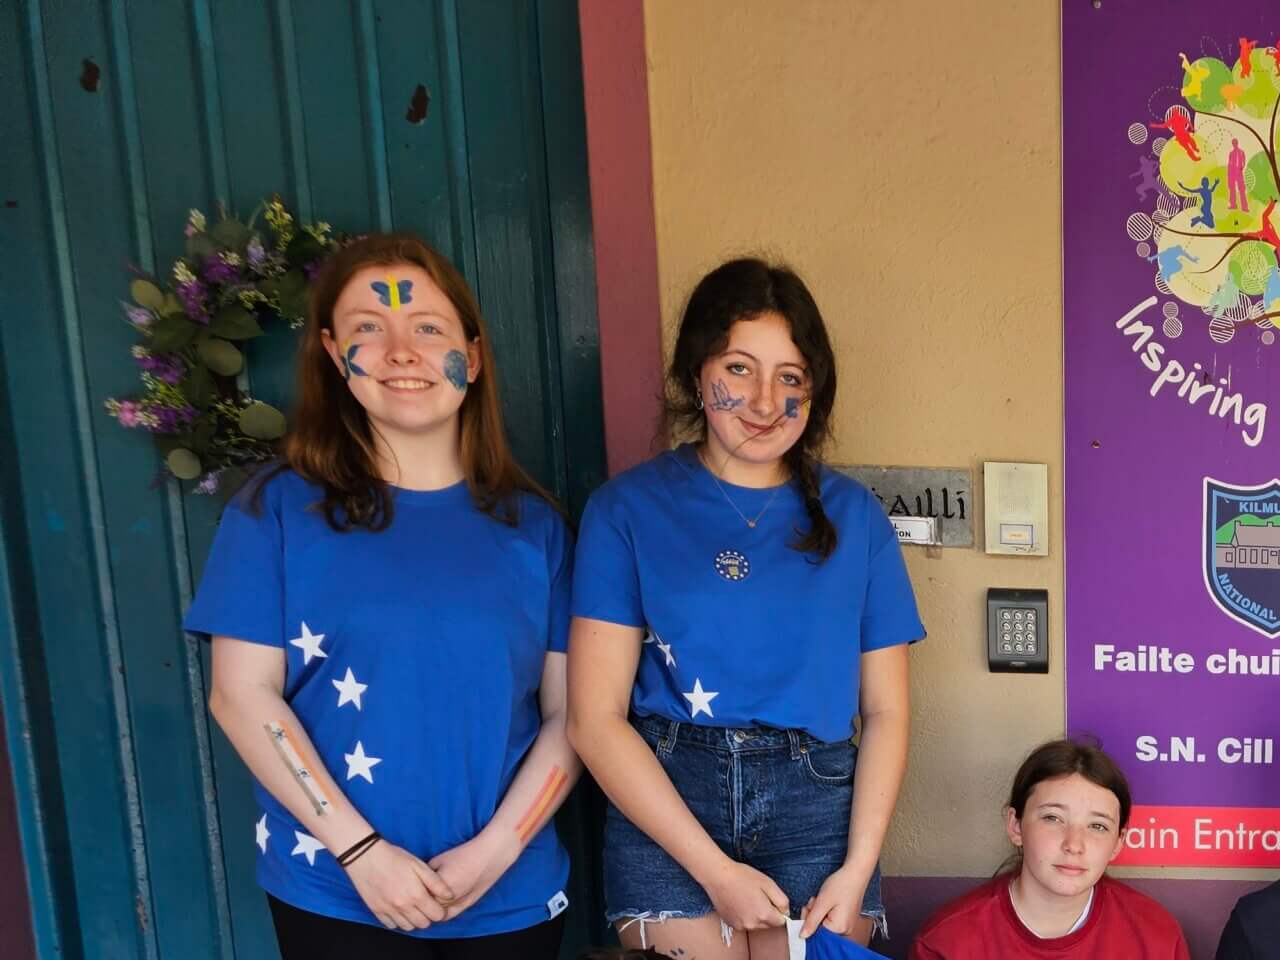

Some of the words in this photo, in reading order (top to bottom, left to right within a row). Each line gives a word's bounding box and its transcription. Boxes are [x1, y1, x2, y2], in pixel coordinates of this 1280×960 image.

[1116, 296, 1267, 447] Inspiring
[1218, 573, 1276, 619] NATIONAL
[1093, 644, 1195, 674] Failte
[1135, 735, 1206, 763] S.N.
[1217, 738, 1273, 764] Cill
[1125, 817, 1179, 849] ain
